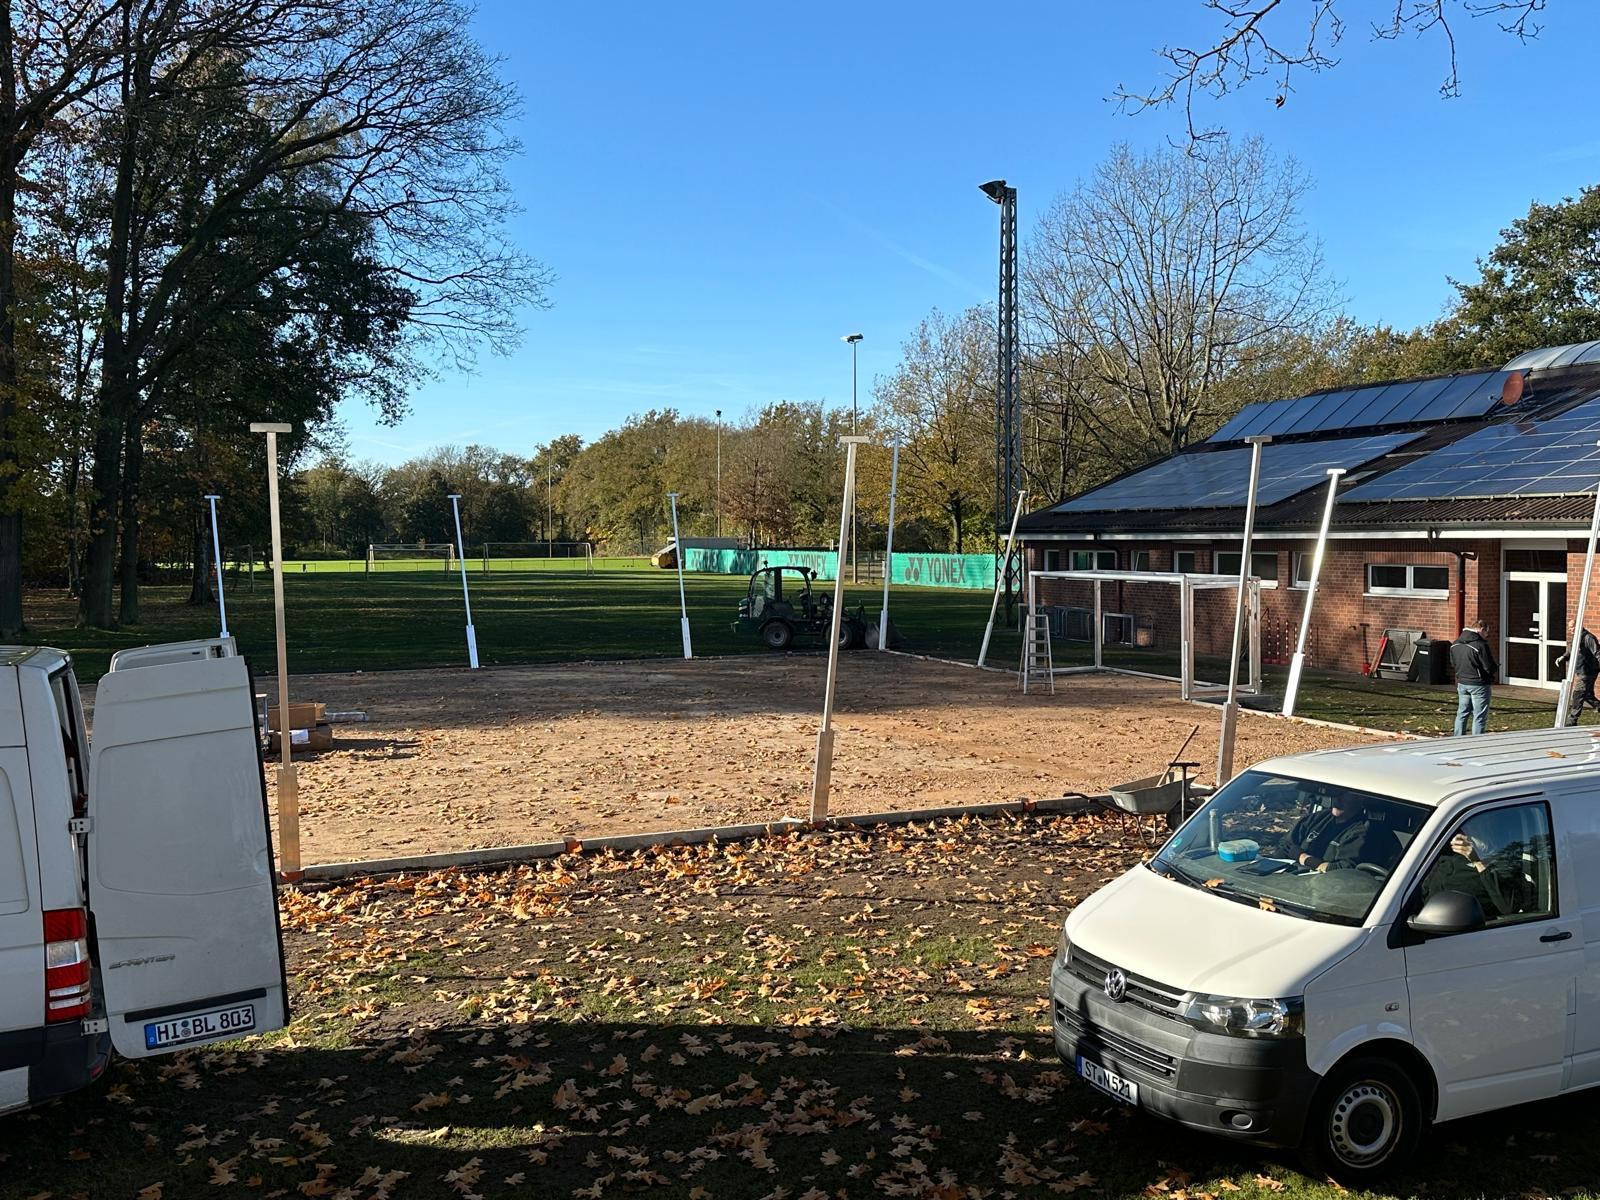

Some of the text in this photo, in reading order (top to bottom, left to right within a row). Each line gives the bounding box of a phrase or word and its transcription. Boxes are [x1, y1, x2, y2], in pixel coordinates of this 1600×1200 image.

[800, 553, 827, 577] YONEX
[927, 557, 966, 584] YONEX
[157, 1023, 180, 1041] HI
[192, 1017, 216, 1035] BL
[220, 1008, 252, 1029] 803
[1111, 1076, 1132, 1101] 521
